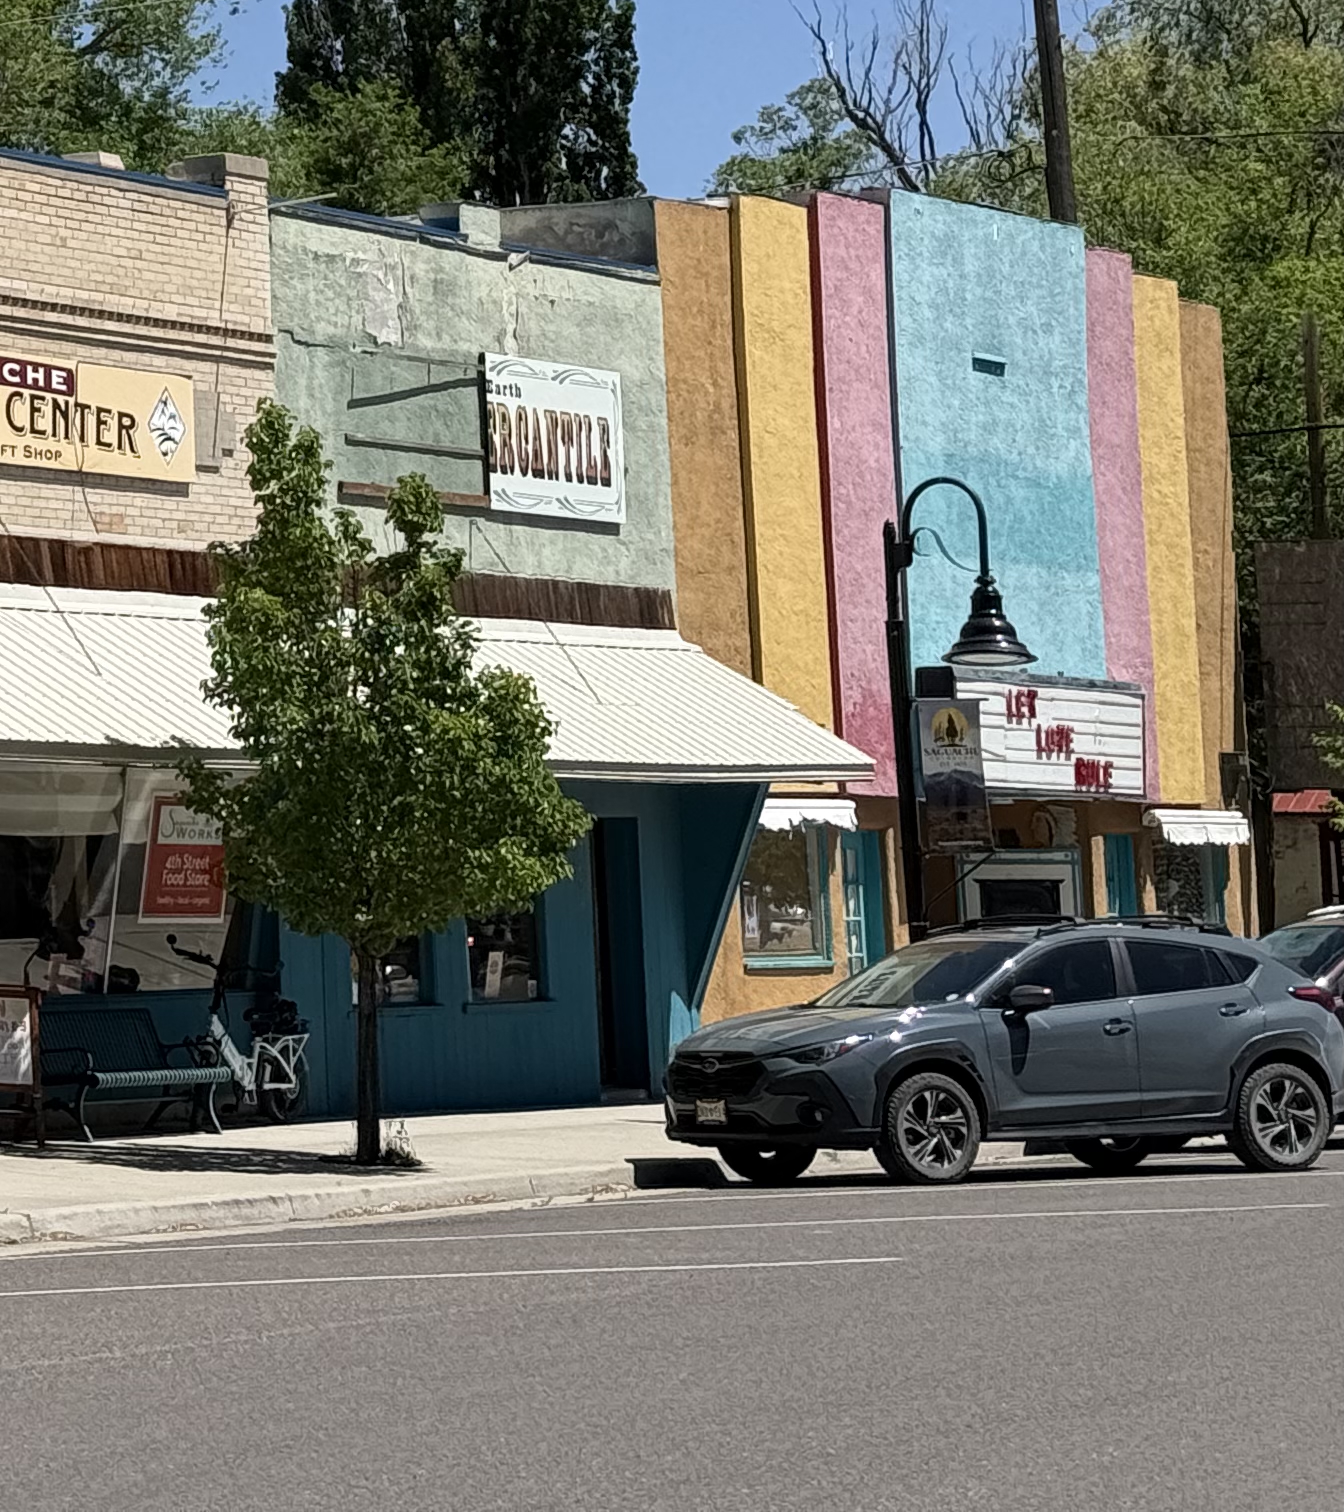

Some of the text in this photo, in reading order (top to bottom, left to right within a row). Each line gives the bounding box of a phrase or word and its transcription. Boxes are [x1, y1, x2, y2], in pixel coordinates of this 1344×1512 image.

[486, 378, 522, 399] Earth
[5, 390, 141, 458] CENTER
[22, 444, 63, 462] SHOP
[487, 400, 612, 488] ERCANTILE
[1005, 688, 1039, 725] LET
[1034, 723, 1075, 759] LOVE
[1074, 757, 1114, 791] RULE
[176, 826, 221, 840] WORKS
[165, 854, 210, 870] 4th Street
[162, 869, 210, 885] Food Store
